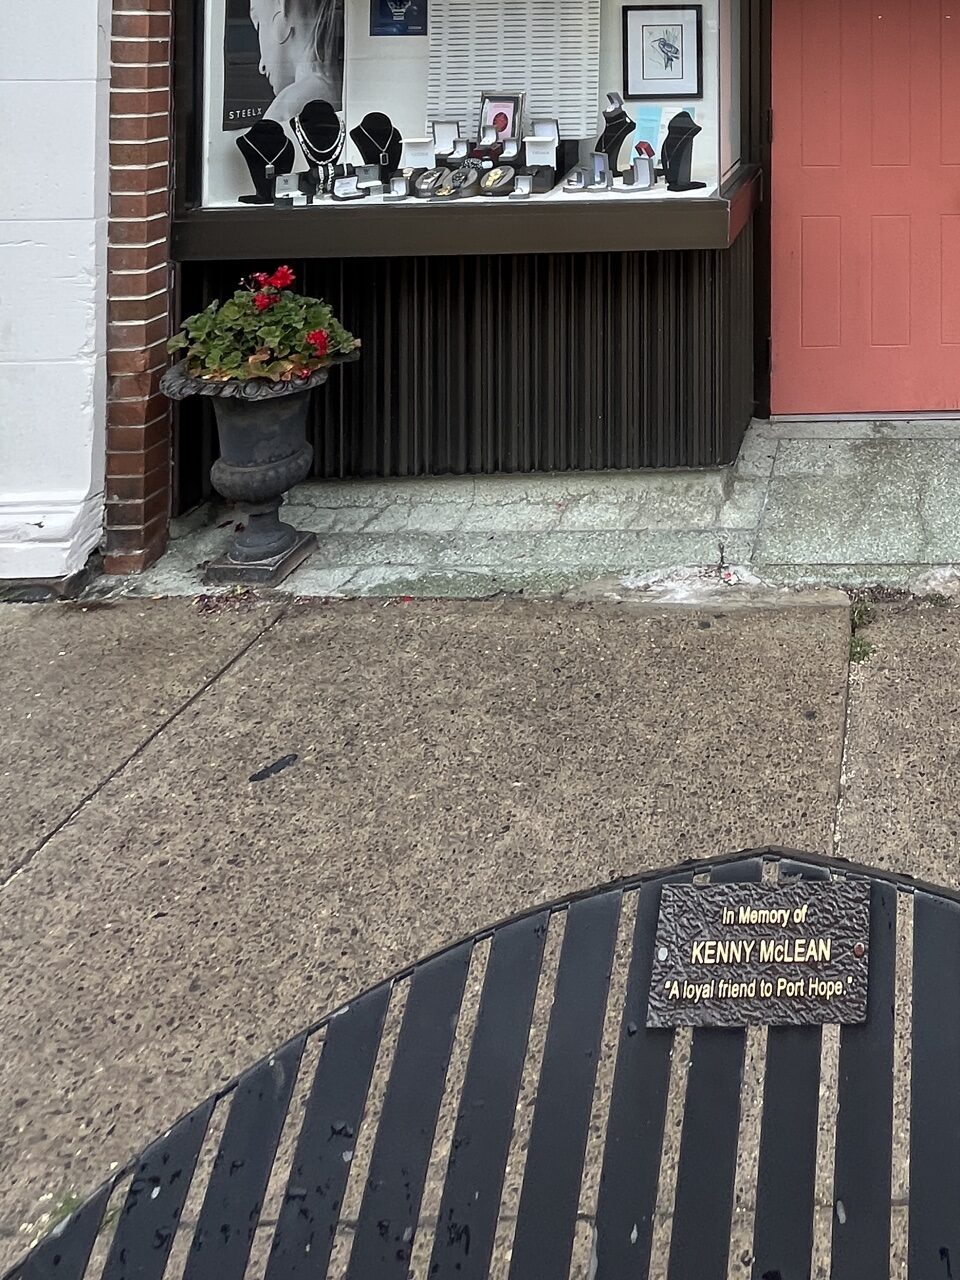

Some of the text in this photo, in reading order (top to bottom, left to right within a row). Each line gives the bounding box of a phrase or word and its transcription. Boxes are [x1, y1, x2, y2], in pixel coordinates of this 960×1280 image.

[228, 107, 262, 120] STEELX
[722, 904, 809, 928] In Memory of
[691, 938, 832, 964] KENNY McLEAN
[682, 980, 714, 1004] loyal
[718, 979, 756, 999] friend
[760, 980, 772, 998] to
[776, 978, 805, 997] Port
